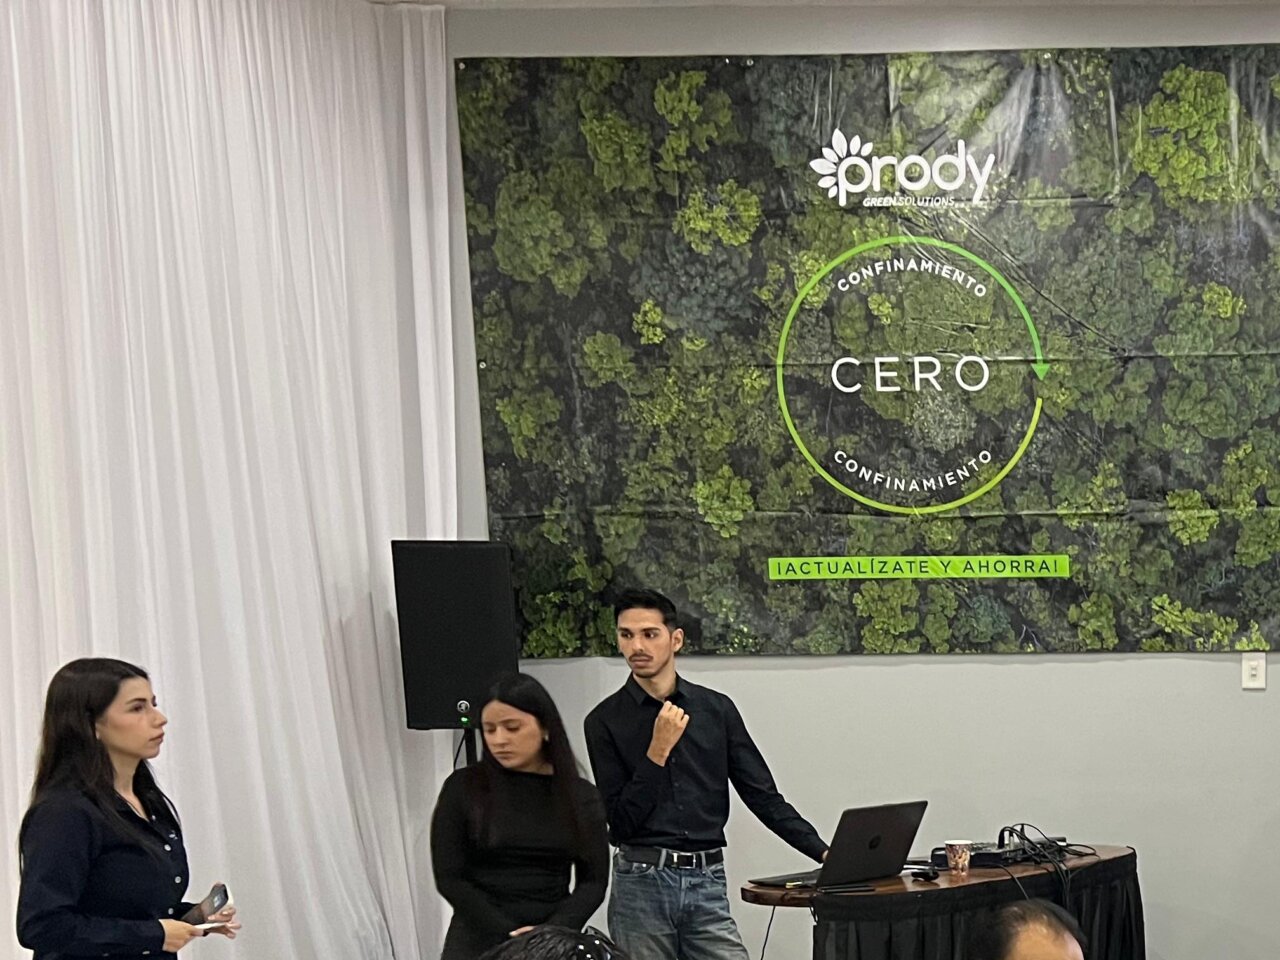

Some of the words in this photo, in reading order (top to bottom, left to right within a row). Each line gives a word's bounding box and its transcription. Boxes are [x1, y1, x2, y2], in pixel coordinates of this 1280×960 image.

[838, 139, 996, 207] prody
[898, 197, 955, 207] SOLUTIONS
[837, 258, 987, 298] CONFINAMIENTO
[831, 355, 990, 393] CERO
[833, 450, 992, 493] CONFINAMIENTO
[941, 560, 952, 574] Y
